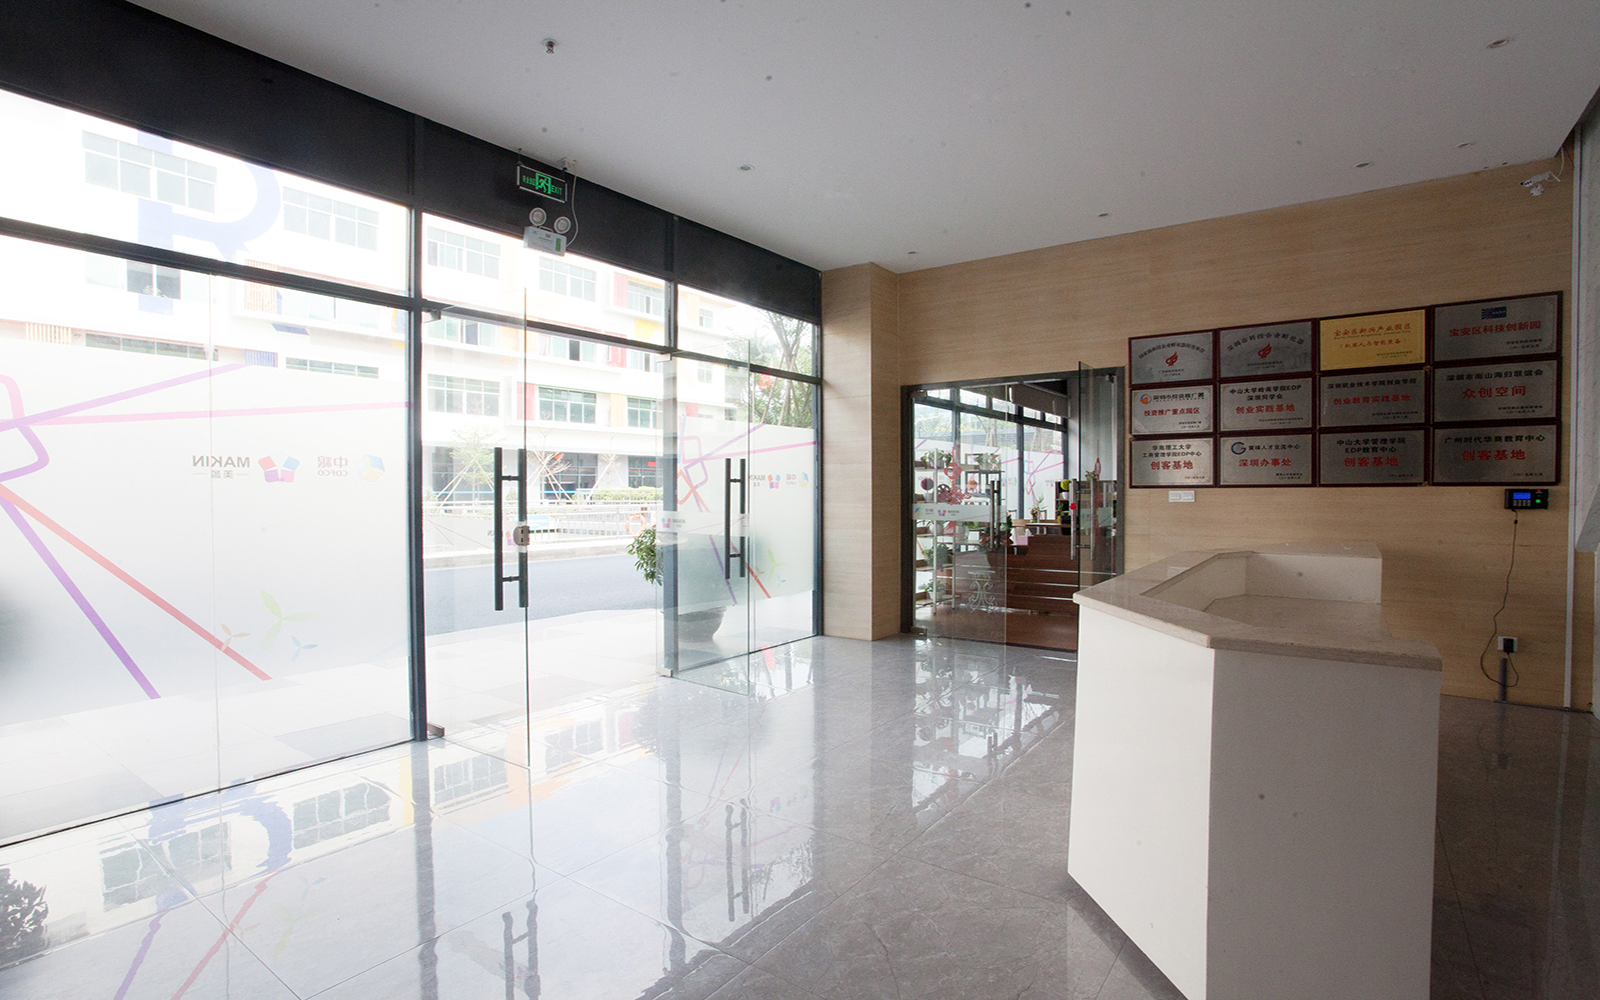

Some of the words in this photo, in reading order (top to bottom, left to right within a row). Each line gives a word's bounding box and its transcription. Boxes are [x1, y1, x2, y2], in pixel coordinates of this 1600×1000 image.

[551, 185, 563, 195] EXIT
[1449, 321, 1541, 337] 宝安区科技创新园
[1446, 369, 1543, 381] 深圳市南山海归联谊会
[1462, 385, 1526, 399] 众创空间
[1333, 394, 1411, 405] 创业教育实践基地
[1144, 407, 1200, 417] 投资推广重点园区
[1236, 404, 1296, 414] 创业实践基地
[1336, 437, 1406, 446] 中山大学管理学院
[1444, 434, 1545, 444] 广州时代华商教育中心
[1461, 449, 1526, 461] 创客基地
[1150, 460, 1194, 470] 创客基地
[1238, 458, 1292, 467] 深圳办事处
[1344, 456, 1399, 467] 创客基地
